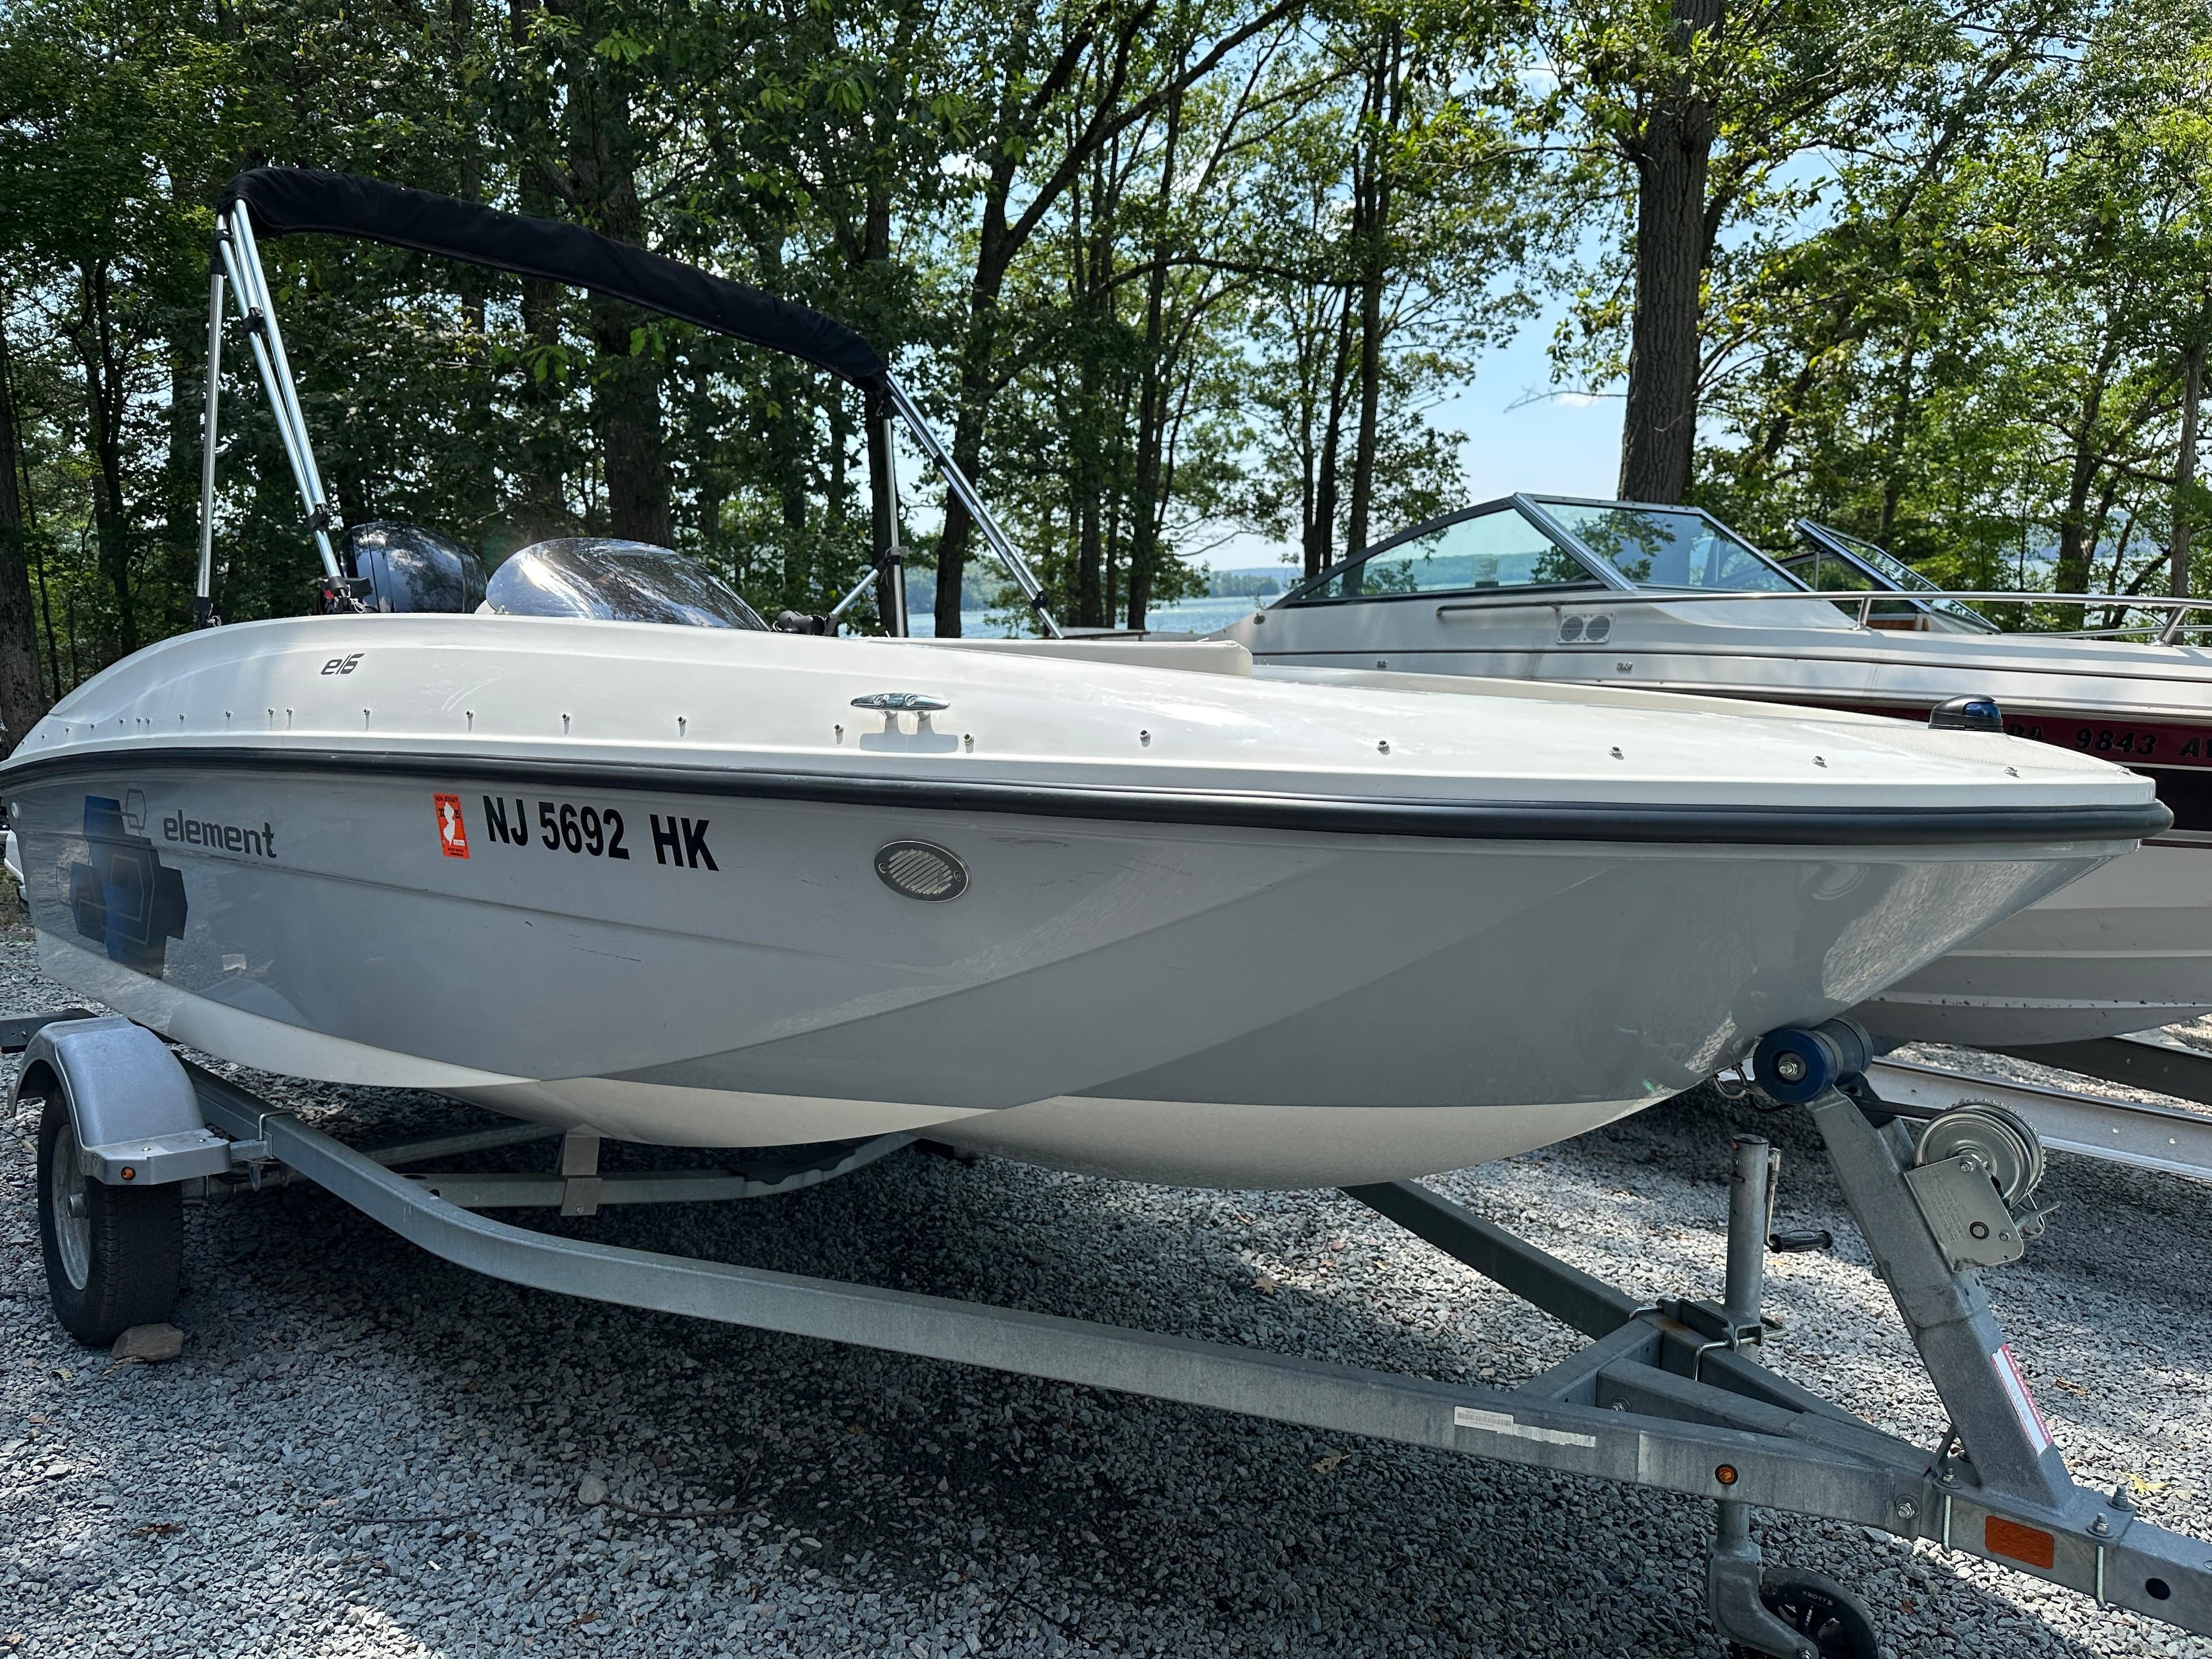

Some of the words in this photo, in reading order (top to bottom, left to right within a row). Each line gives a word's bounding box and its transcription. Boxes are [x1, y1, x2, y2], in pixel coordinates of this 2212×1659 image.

[2076, 728, 2157, 756] 9843
[163, 809, 276, 858] element
[483, 796, 528, 846] NJ
[539, 801, 630, 860] 5692
[649, 814, 719, 871] HK
[2027, 1396, 2049, 1440] MARINA
[1802, 1590, 1827, 1603] KNOTT
